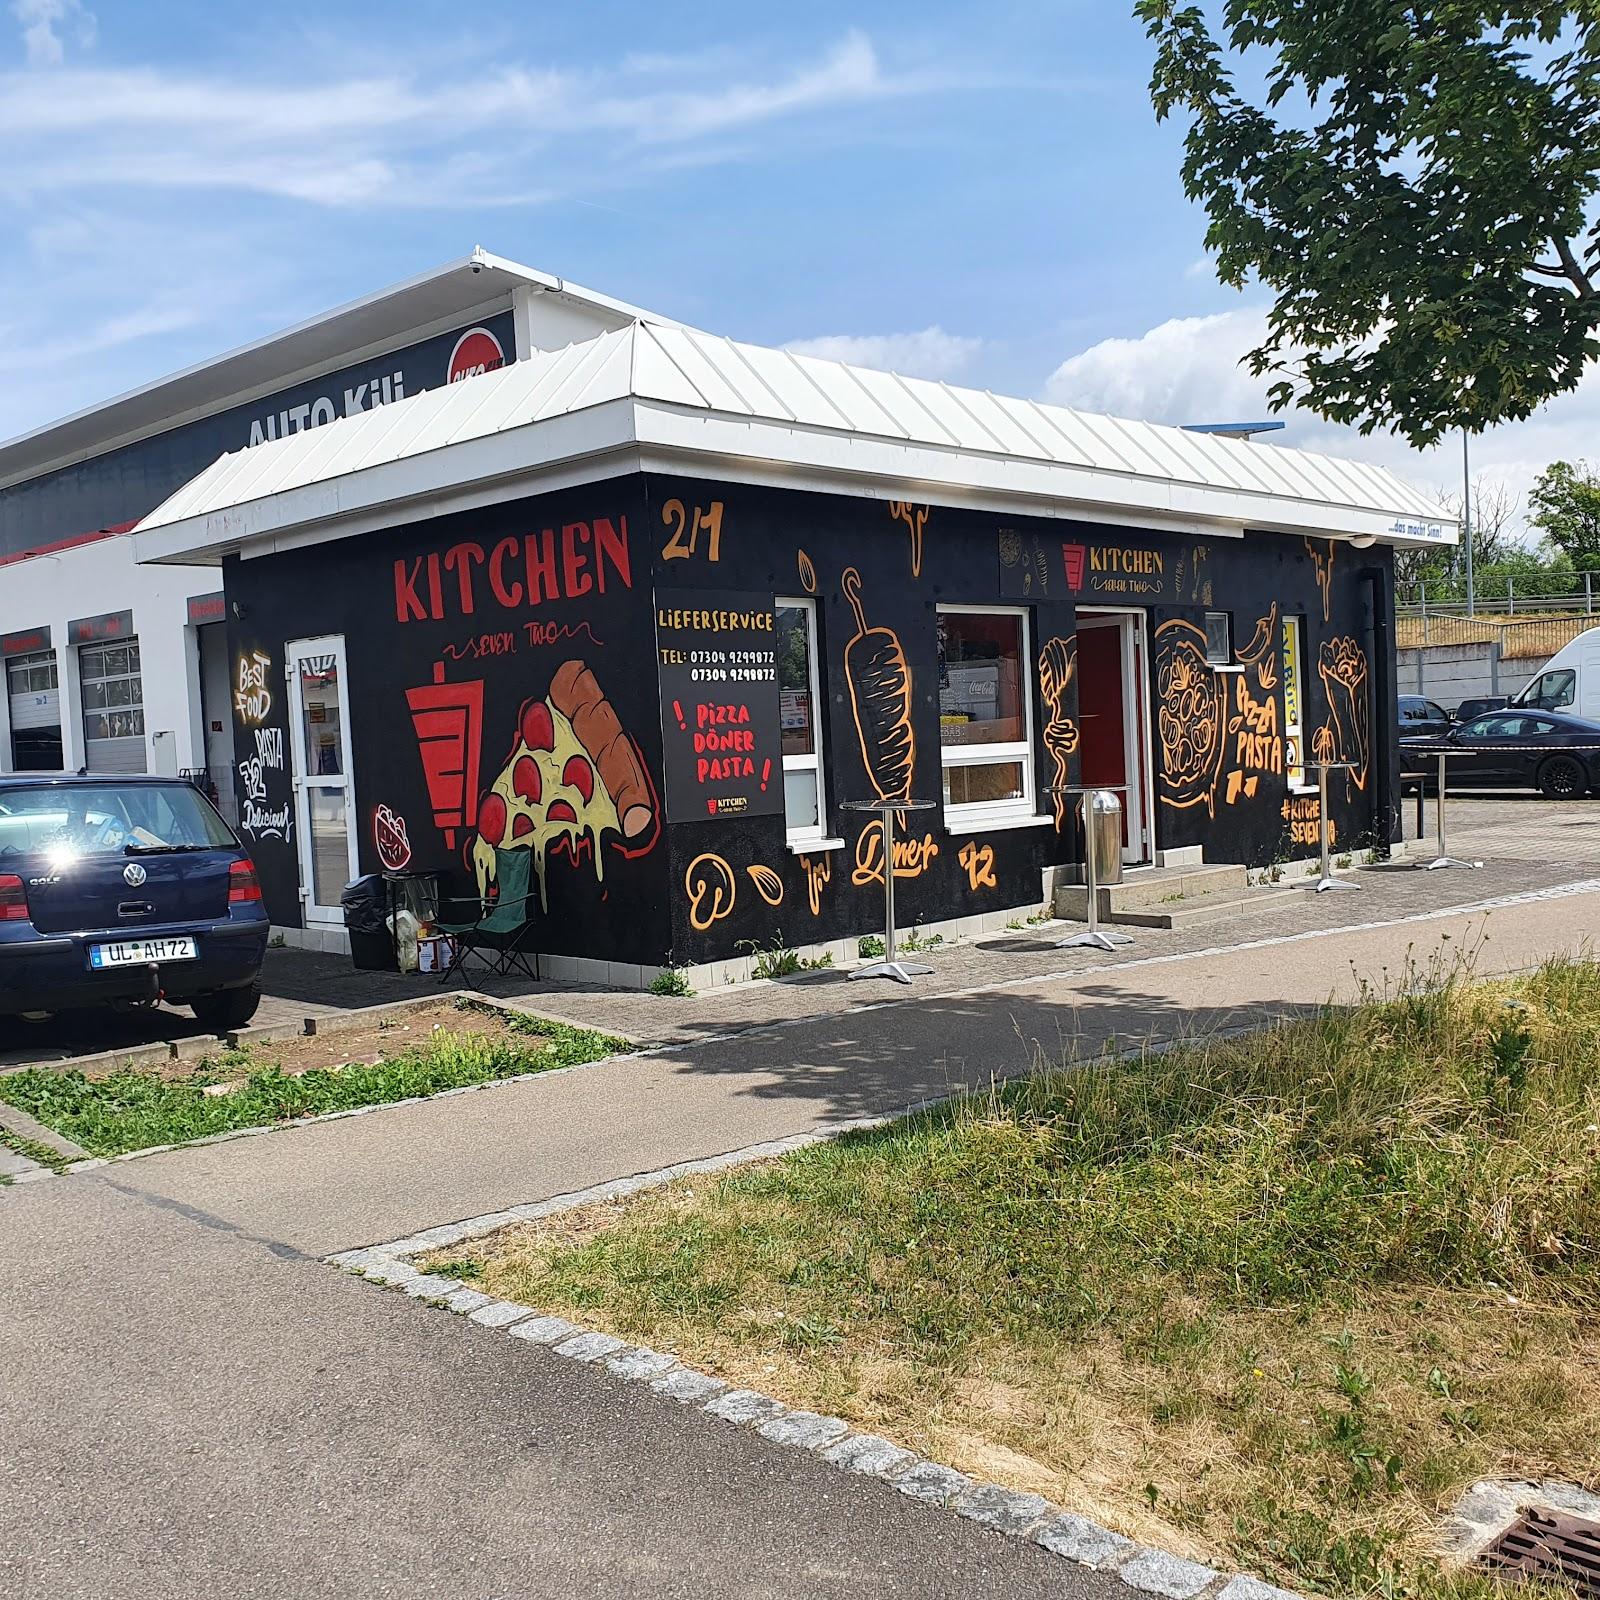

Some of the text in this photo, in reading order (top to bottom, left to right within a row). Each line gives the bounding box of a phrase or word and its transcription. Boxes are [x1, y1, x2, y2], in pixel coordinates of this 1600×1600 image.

[394, 515, 632, 622] KITCHEN
[1090, 547, 1163, 574] KITCHEN
[458, 621, 568, 658] SEVEN TWO
[239, 651, 271, 692] BEST
[661, 650, 774, 664] TEL: 07304 9299872
[691, 668, 775, 681] 07304 9298872
[235, 690, 271, 724] FOOD
[1236, 675, 1276, 736] PIZZA
[254, 727, 283, 771] PASTA
[693, 728, 755, 753] DÖNER
[1236, 731, 1282, 774] PASTA
[697, 757, 754, 783] PASTA
[852, 820, 938, 885] Dner
[30, 876, 61, 886] GOLF
[108, 944, 132, 961] UL
